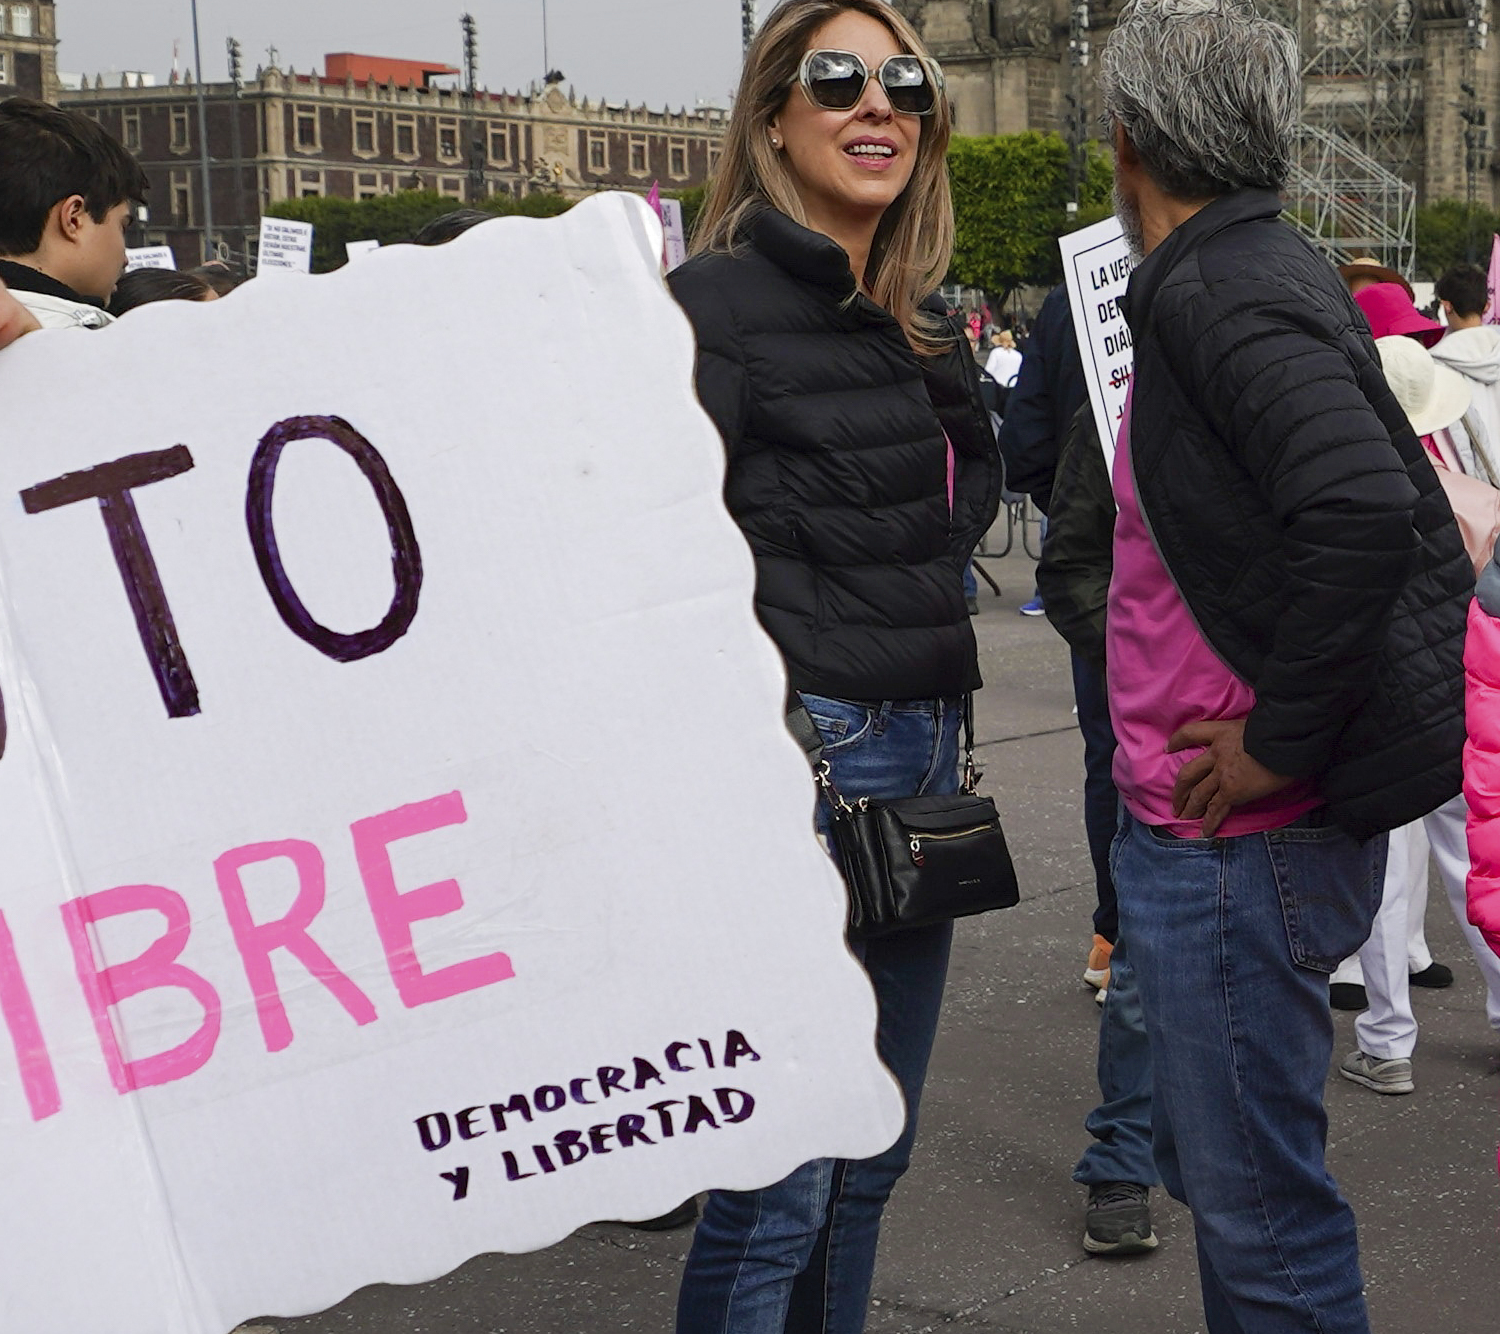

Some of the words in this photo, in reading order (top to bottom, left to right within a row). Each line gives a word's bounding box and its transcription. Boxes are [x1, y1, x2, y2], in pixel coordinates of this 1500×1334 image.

[1091, 267, 1109, 291] LA
[413, 1028, 761, 1152] DEMOCRACIA
[503, 1086, 756, 1183] LIBERTAD
